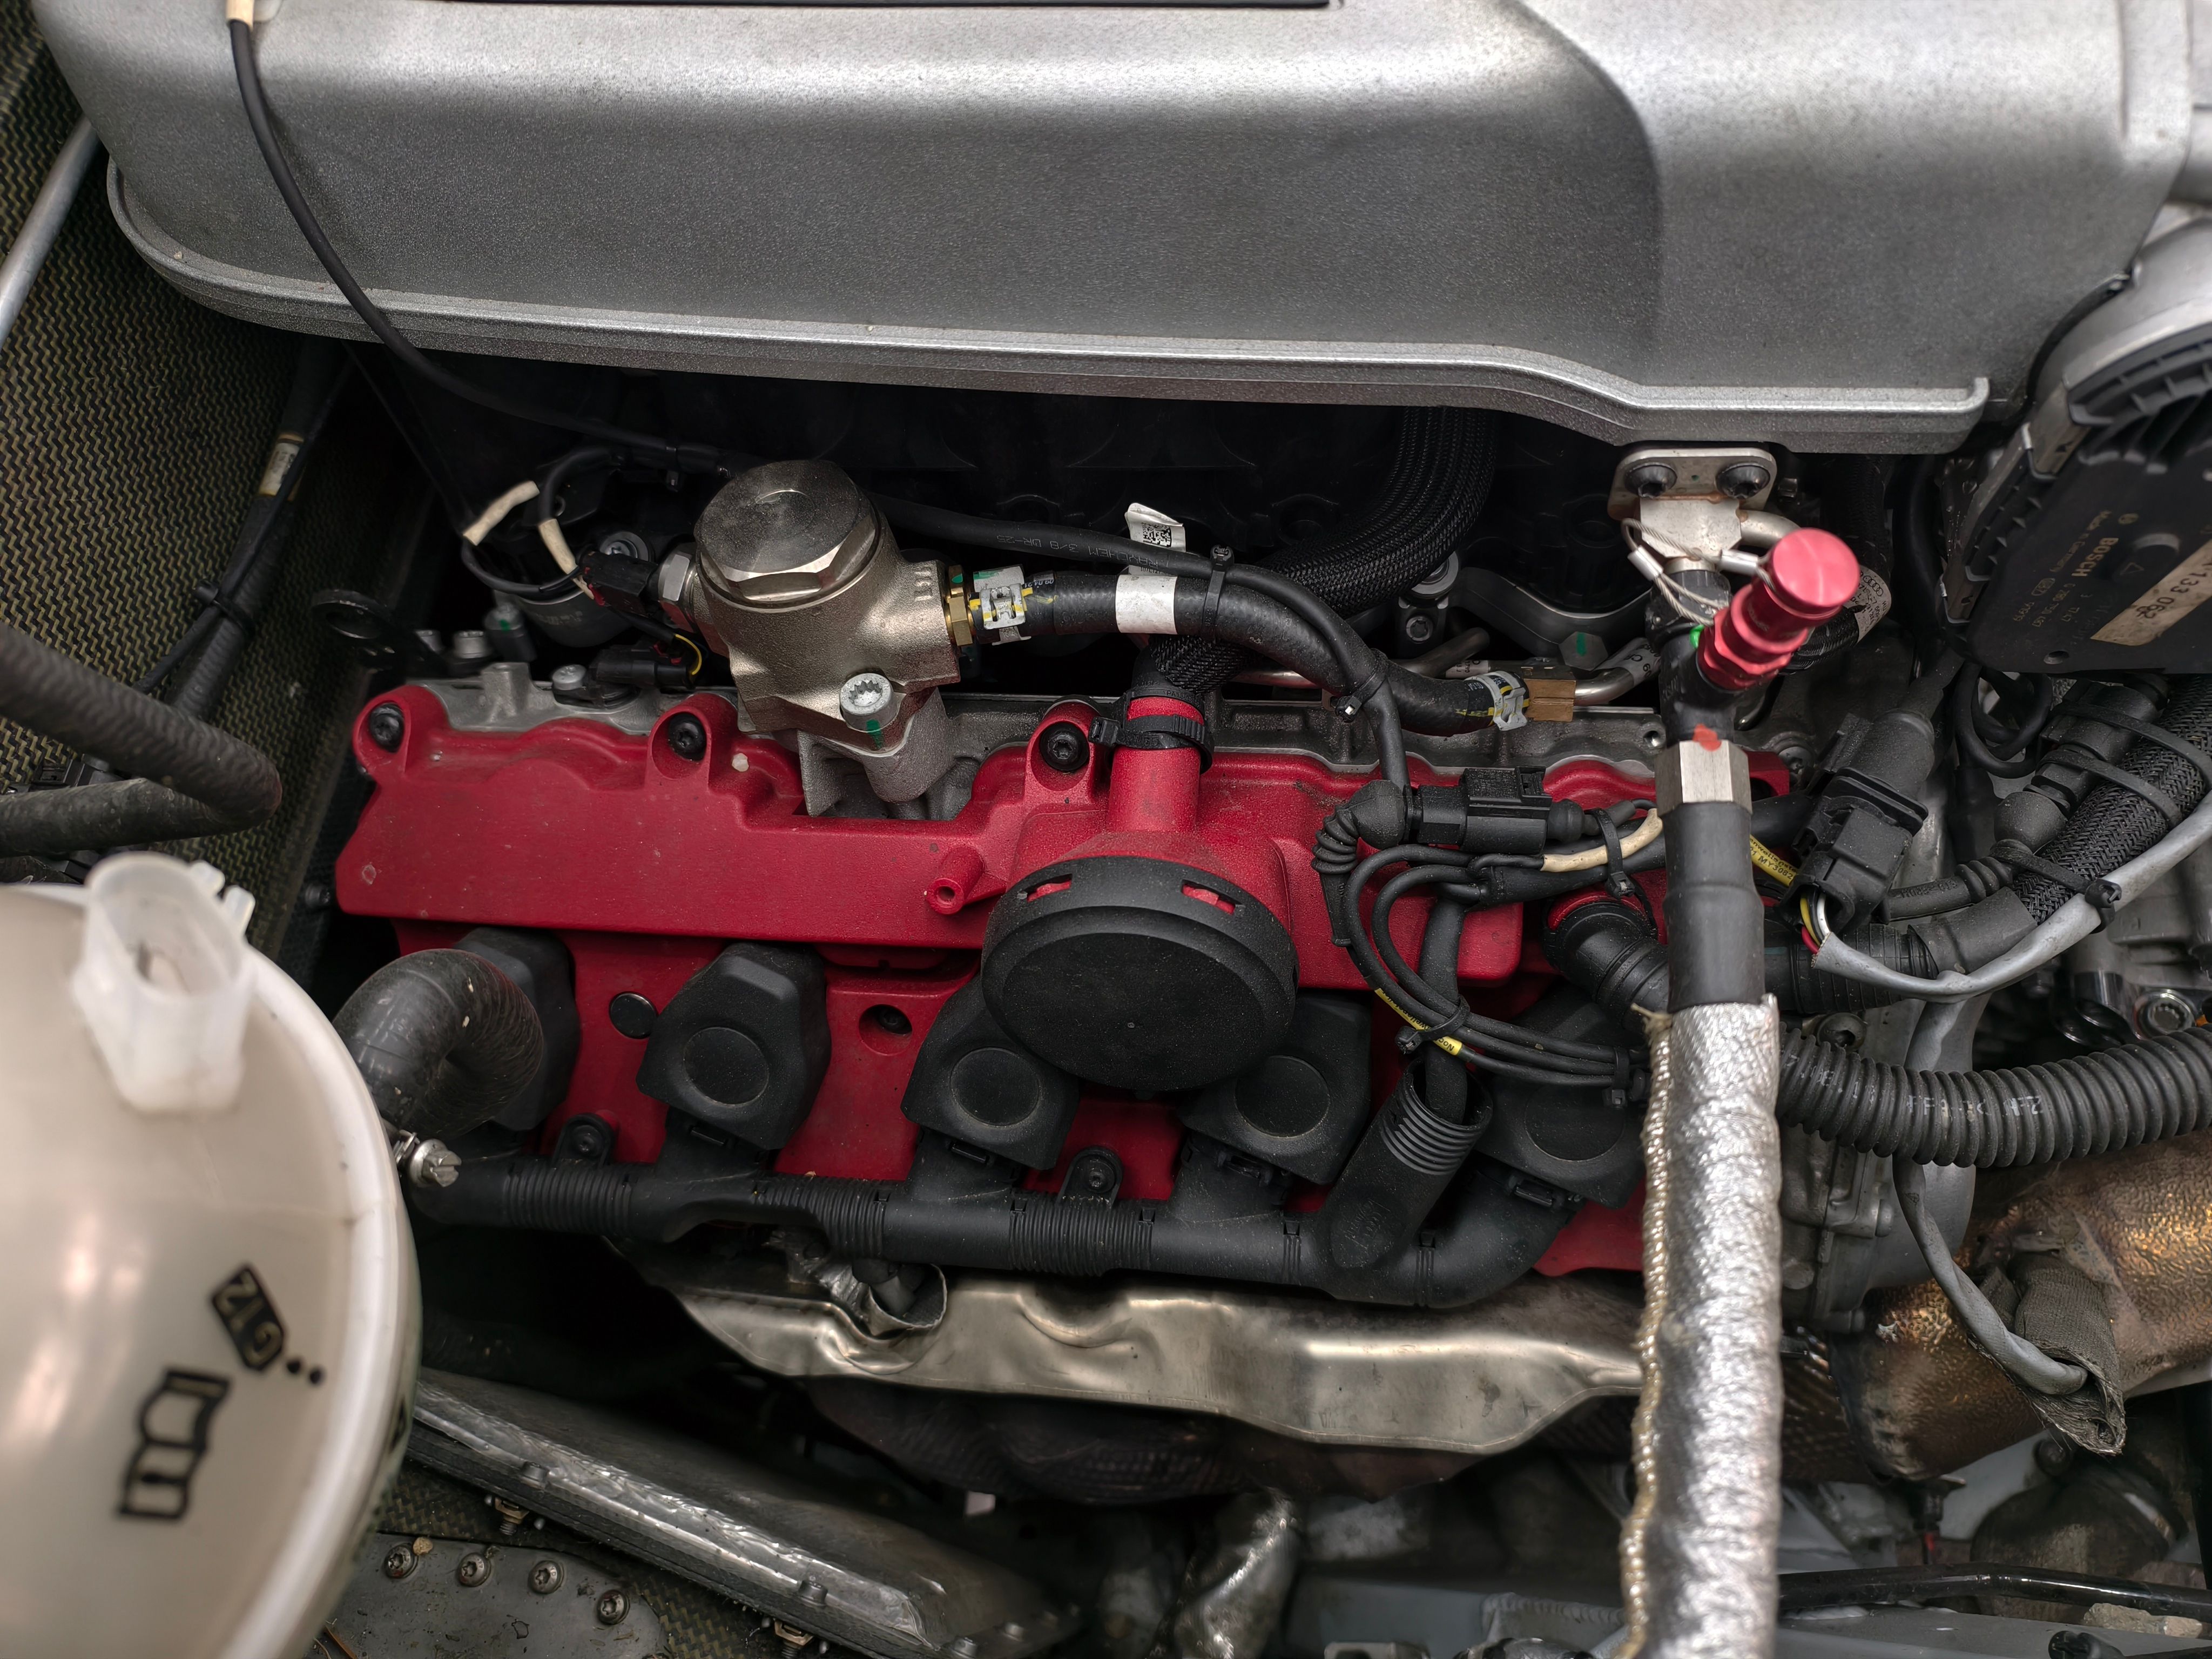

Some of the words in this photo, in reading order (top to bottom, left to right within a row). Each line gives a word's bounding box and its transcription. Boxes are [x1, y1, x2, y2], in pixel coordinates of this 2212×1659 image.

[996, 535, 1042, 548] DR-25
[1049, 541, 1078, 552] 3/8
[1088, 547, 1158, 567] RAYCHEM
[2072, 537, 2119, 577] BOSCH
[2170, 572, 2207, 594] 133
[1758, 856, 1793, 879] MY3082
[215, 1271, 284, 1364] G12
